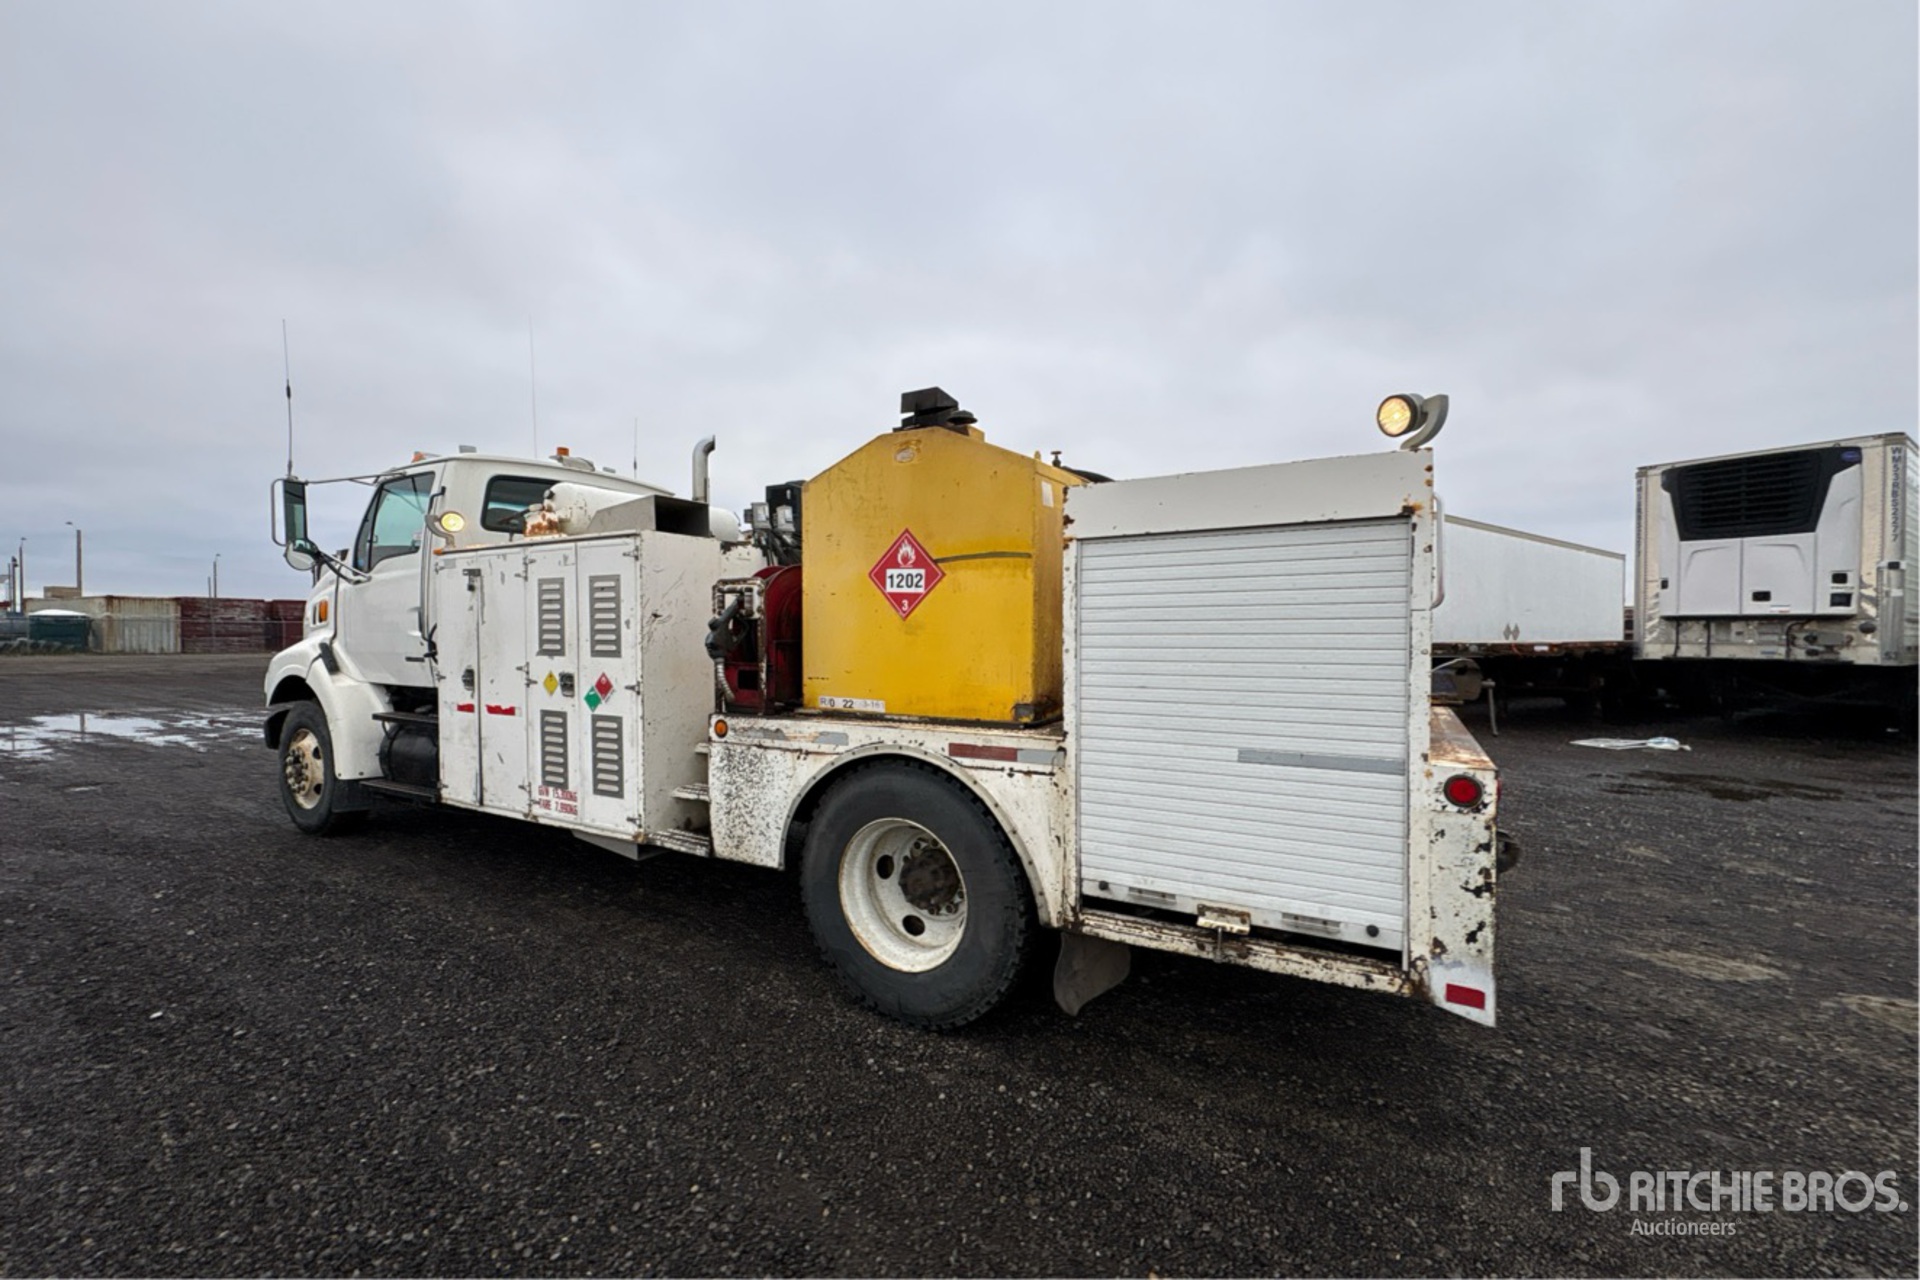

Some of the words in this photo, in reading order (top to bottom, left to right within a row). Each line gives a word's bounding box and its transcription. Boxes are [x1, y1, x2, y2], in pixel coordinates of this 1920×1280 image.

[887, 572, 924, 589] 1202
[901, 599, 909, 611] 3
[842, 699, 854, 709] 22
